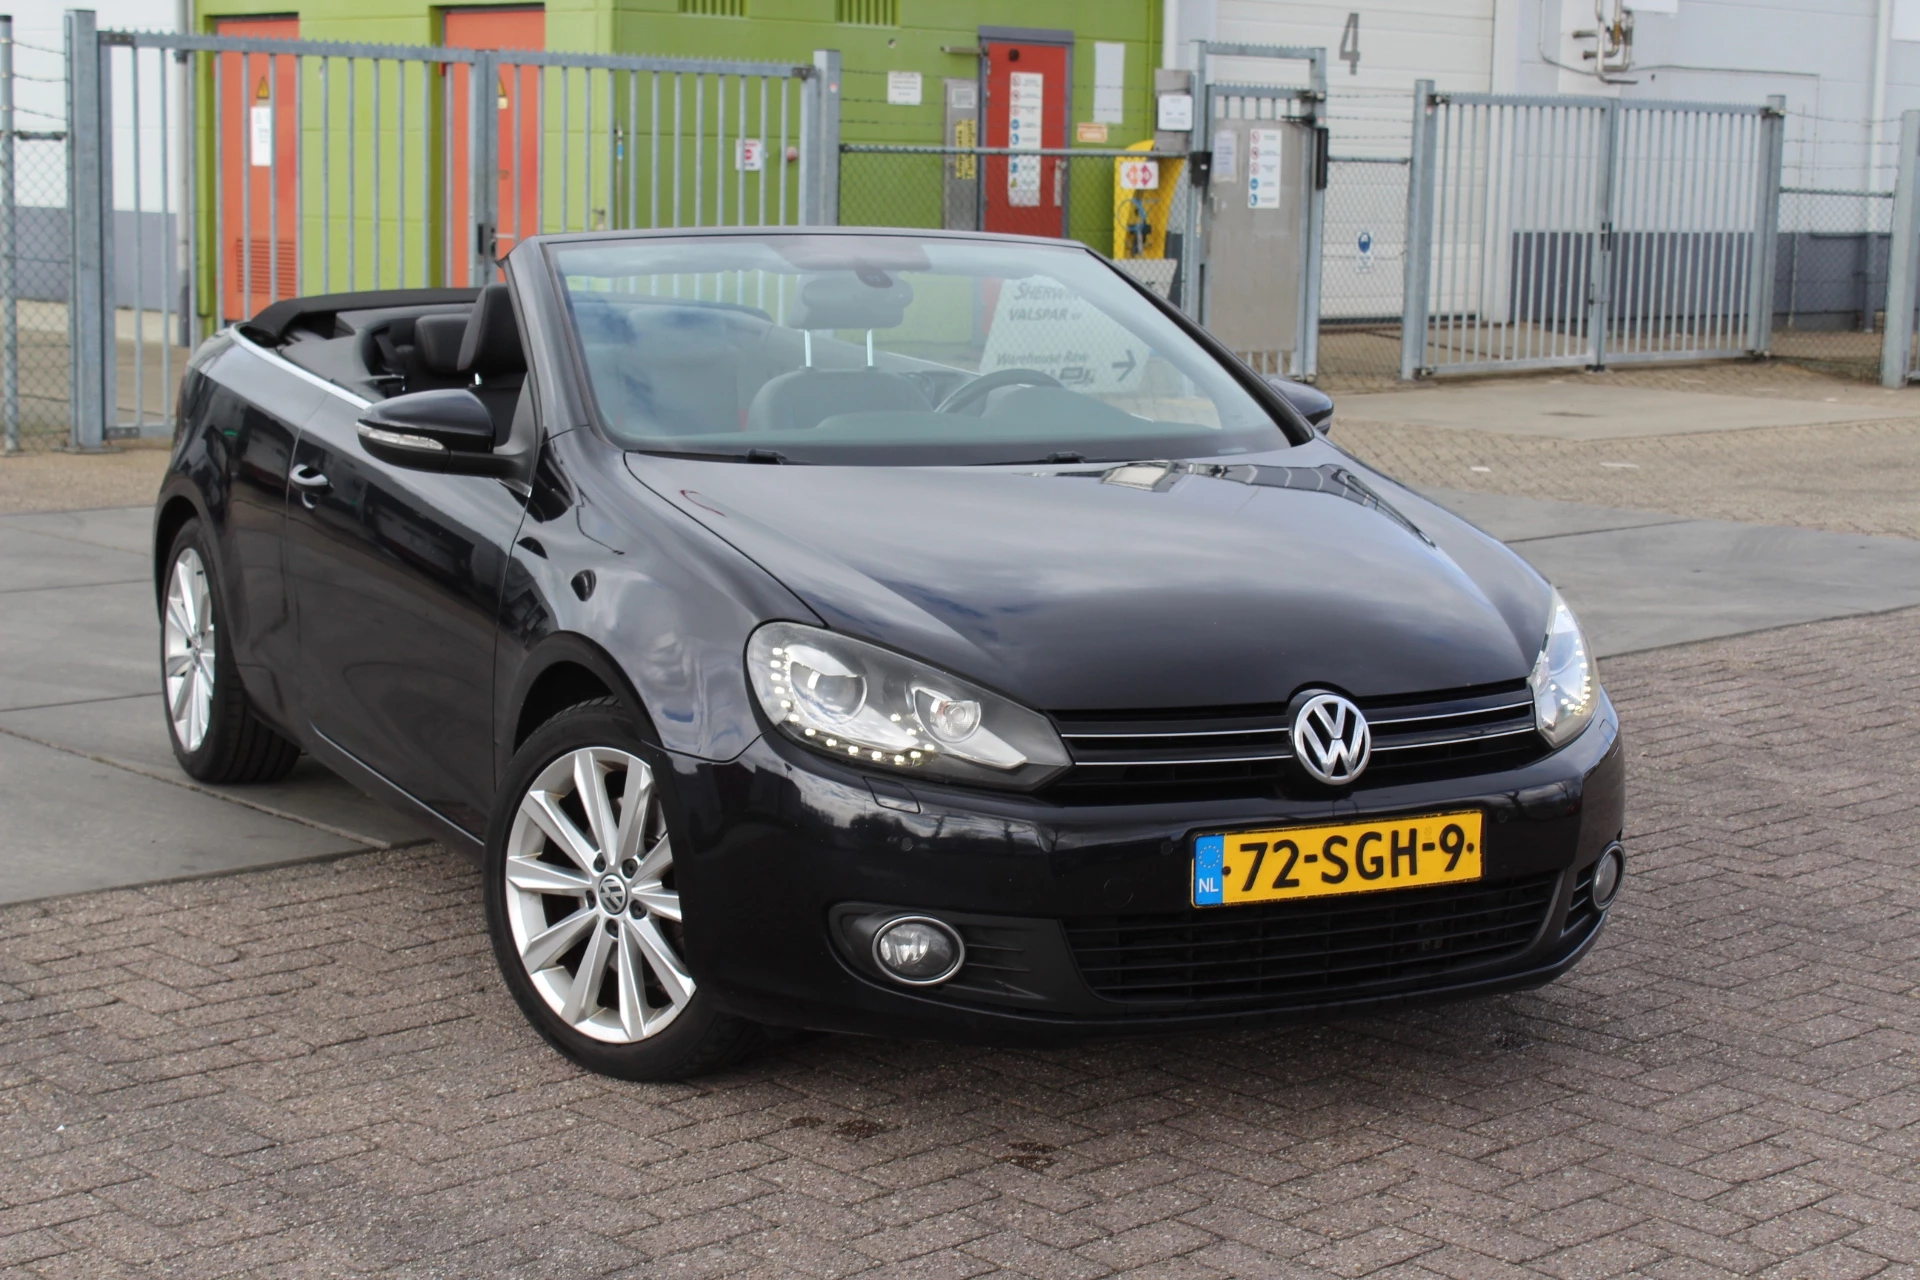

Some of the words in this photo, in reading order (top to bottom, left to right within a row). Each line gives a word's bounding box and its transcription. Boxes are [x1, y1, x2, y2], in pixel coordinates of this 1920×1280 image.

[1339, 13, 1360, 75] 4
[1009, 308, 1068, 321] VALSPAR
[1239, 823, 1465, 892] 72-SGH-9
[1198, 878, 1219, 893] NL
